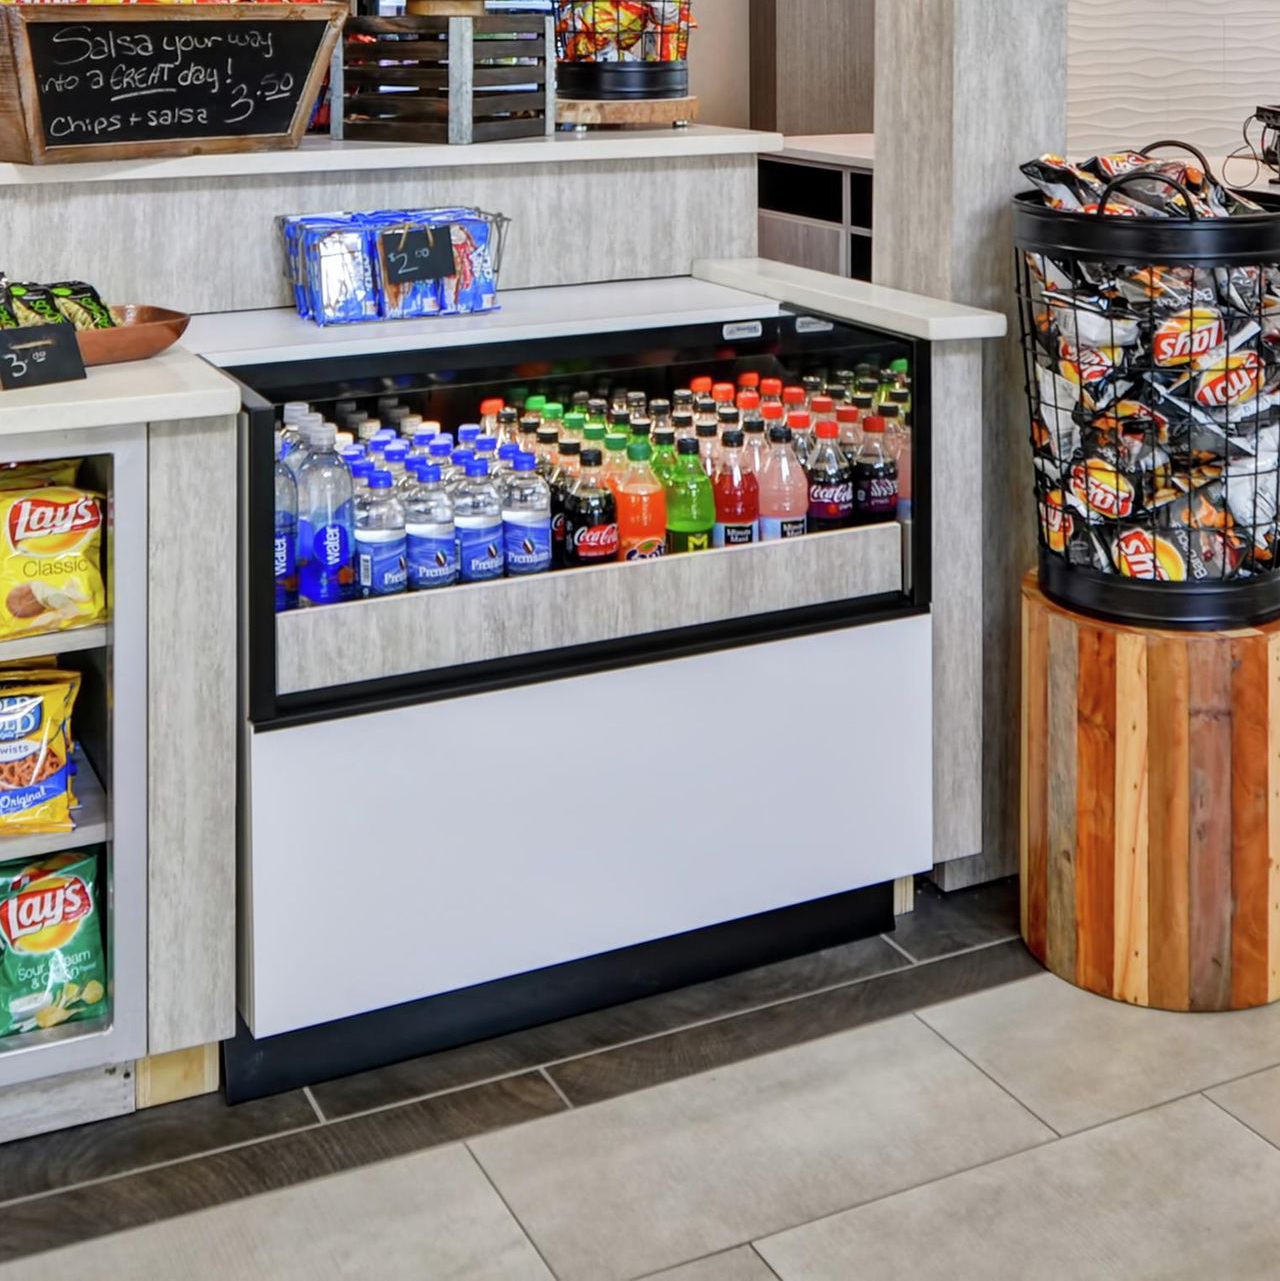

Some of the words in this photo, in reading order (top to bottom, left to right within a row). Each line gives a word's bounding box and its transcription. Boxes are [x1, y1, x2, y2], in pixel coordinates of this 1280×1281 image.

[52, 25, 154, 65] Salsa
[162, 32, 223, 65] your
[228, 30, 273, 58] way
[39, 73, 79, 94] into
[86, 69, 104, 89] a
[109, 63, 175, 90] GREAT
[50, 114, 121, 137] Chips
[147, 107, 208, 126] salsa
[327, 525, 341, 567] water
[22, 558, 89, 578] Classic
[0, 785, 46, 809] Original
[17, 963, 45, 982] Sour
